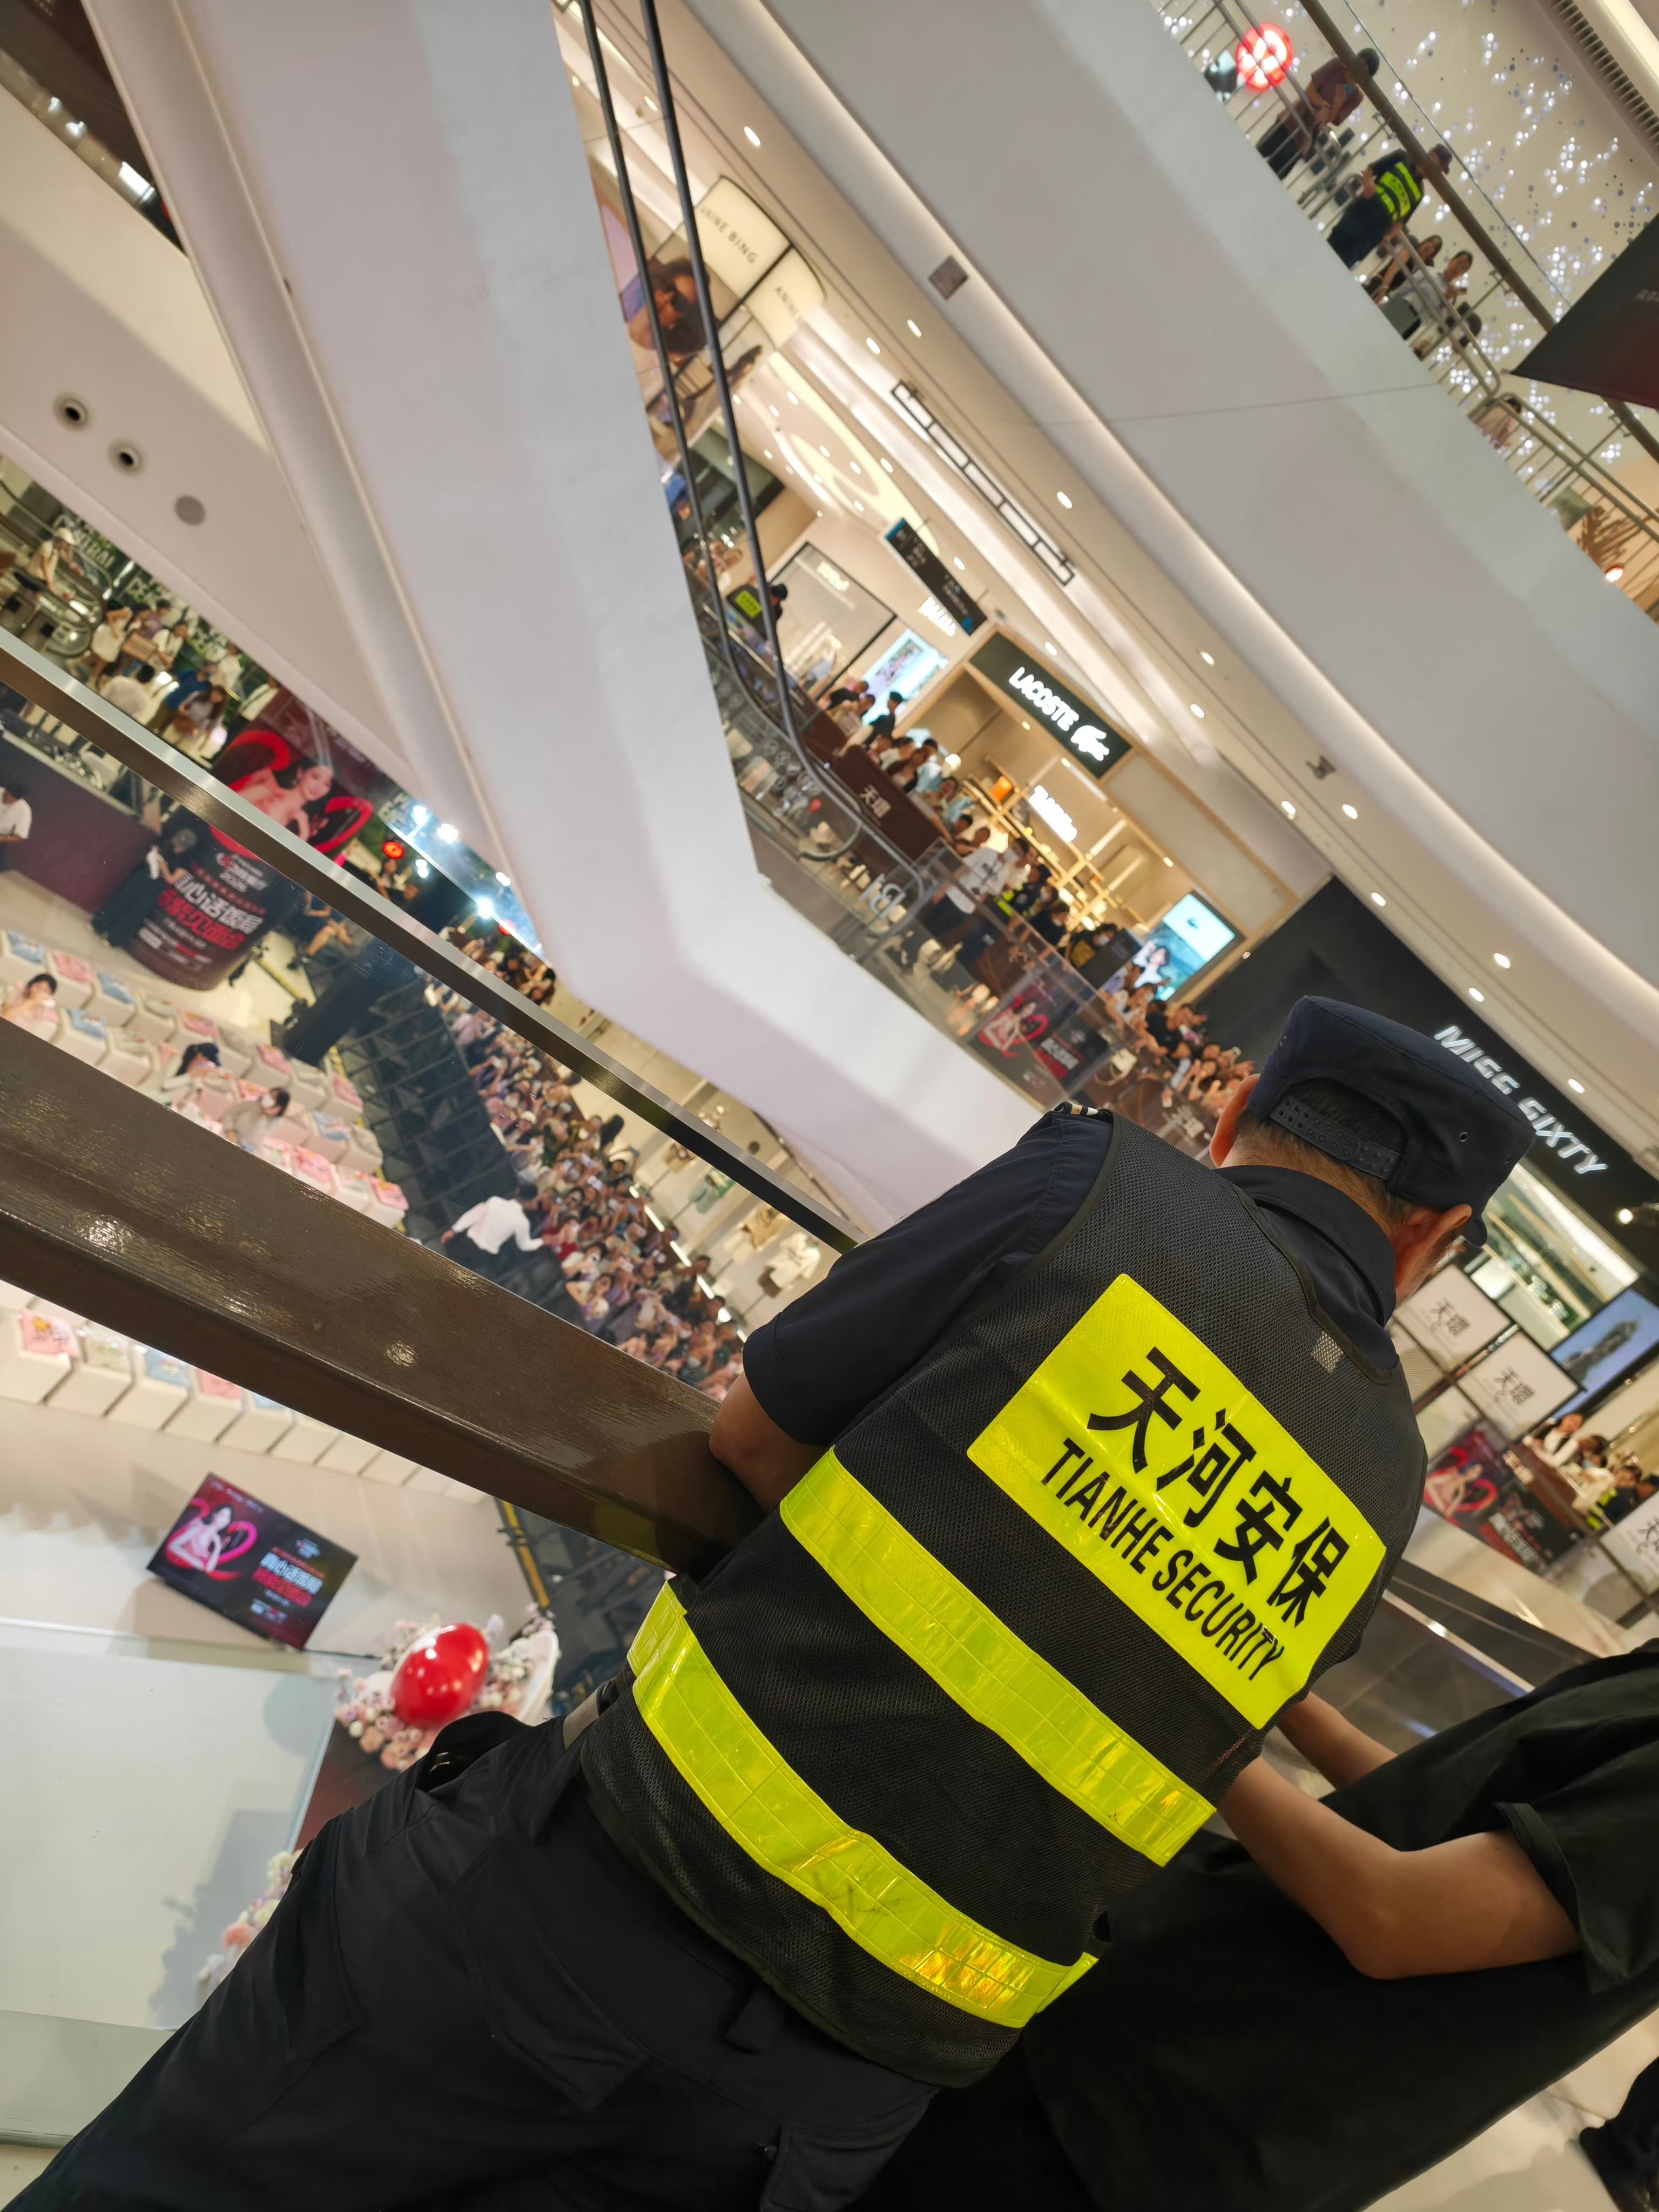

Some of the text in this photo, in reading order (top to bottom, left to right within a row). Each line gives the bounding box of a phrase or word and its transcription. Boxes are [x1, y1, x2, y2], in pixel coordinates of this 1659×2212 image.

[727, 231, 758, 264] BING
[1008, 666, 1080, 731] LACOSTE
[1434, 1026, 1609, 1175] MISS SIXTY
[1041, 1438, 1284, 1681] TIANHE SECURITY
[1087, 1346, 1350, 1628] 天河安保
